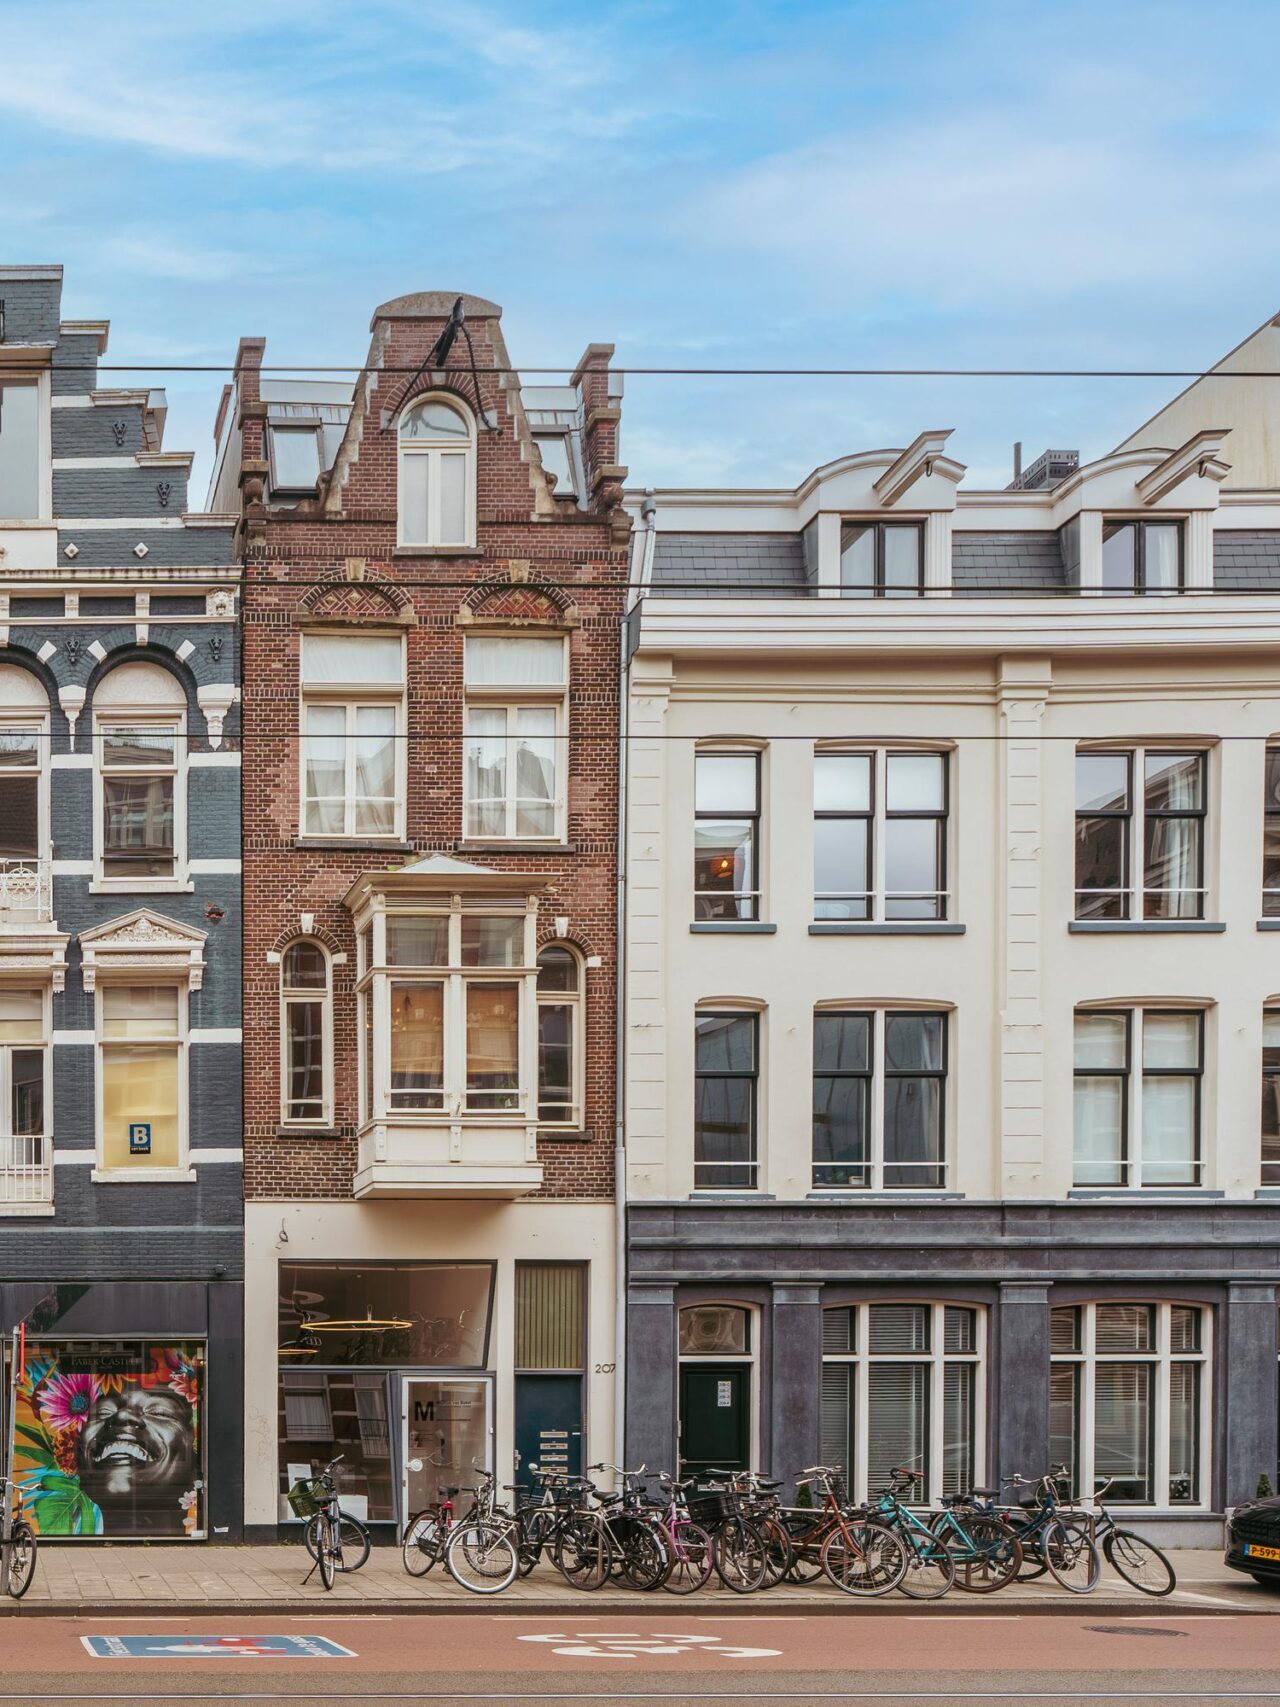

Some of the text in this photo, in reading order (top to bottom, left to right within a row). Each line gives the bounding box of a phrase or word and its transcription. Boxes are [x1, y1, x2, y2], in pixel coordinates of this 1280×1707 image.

[134, 1127, 147, 1144] B
[595, 1363, 616, 1374] 207
[414, 1401, 434, 1421] M
